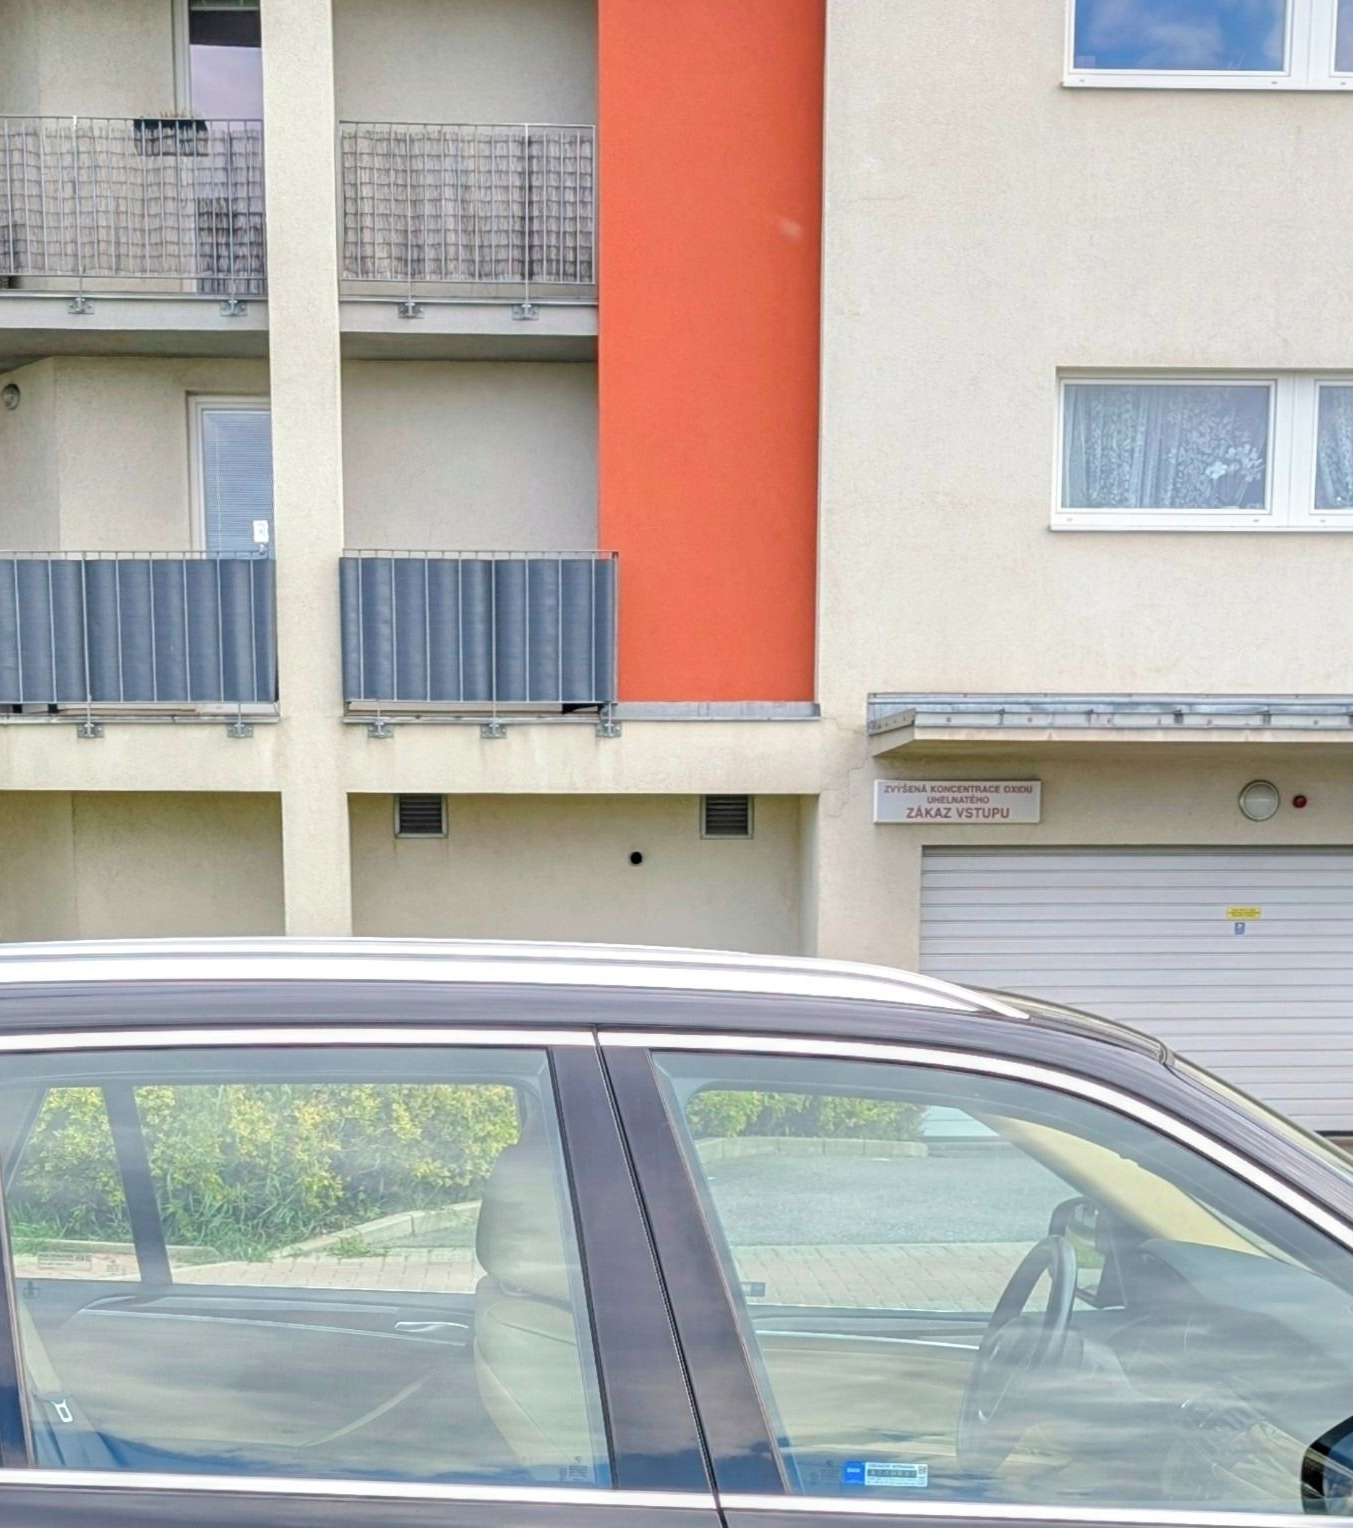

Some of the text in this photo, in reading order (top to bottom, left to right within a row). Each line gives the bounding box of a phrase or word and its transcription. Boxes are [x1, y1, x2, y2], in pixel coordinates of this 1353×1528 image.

[930, 785, 1001, 793] KONCENTRACE
[1003, 786, 1033, 794] OXIDU
[927, 794, 990, 804] UHELNATÉHO
[906, 806, 1010, 819] ZÁKAZ VSTUPU
